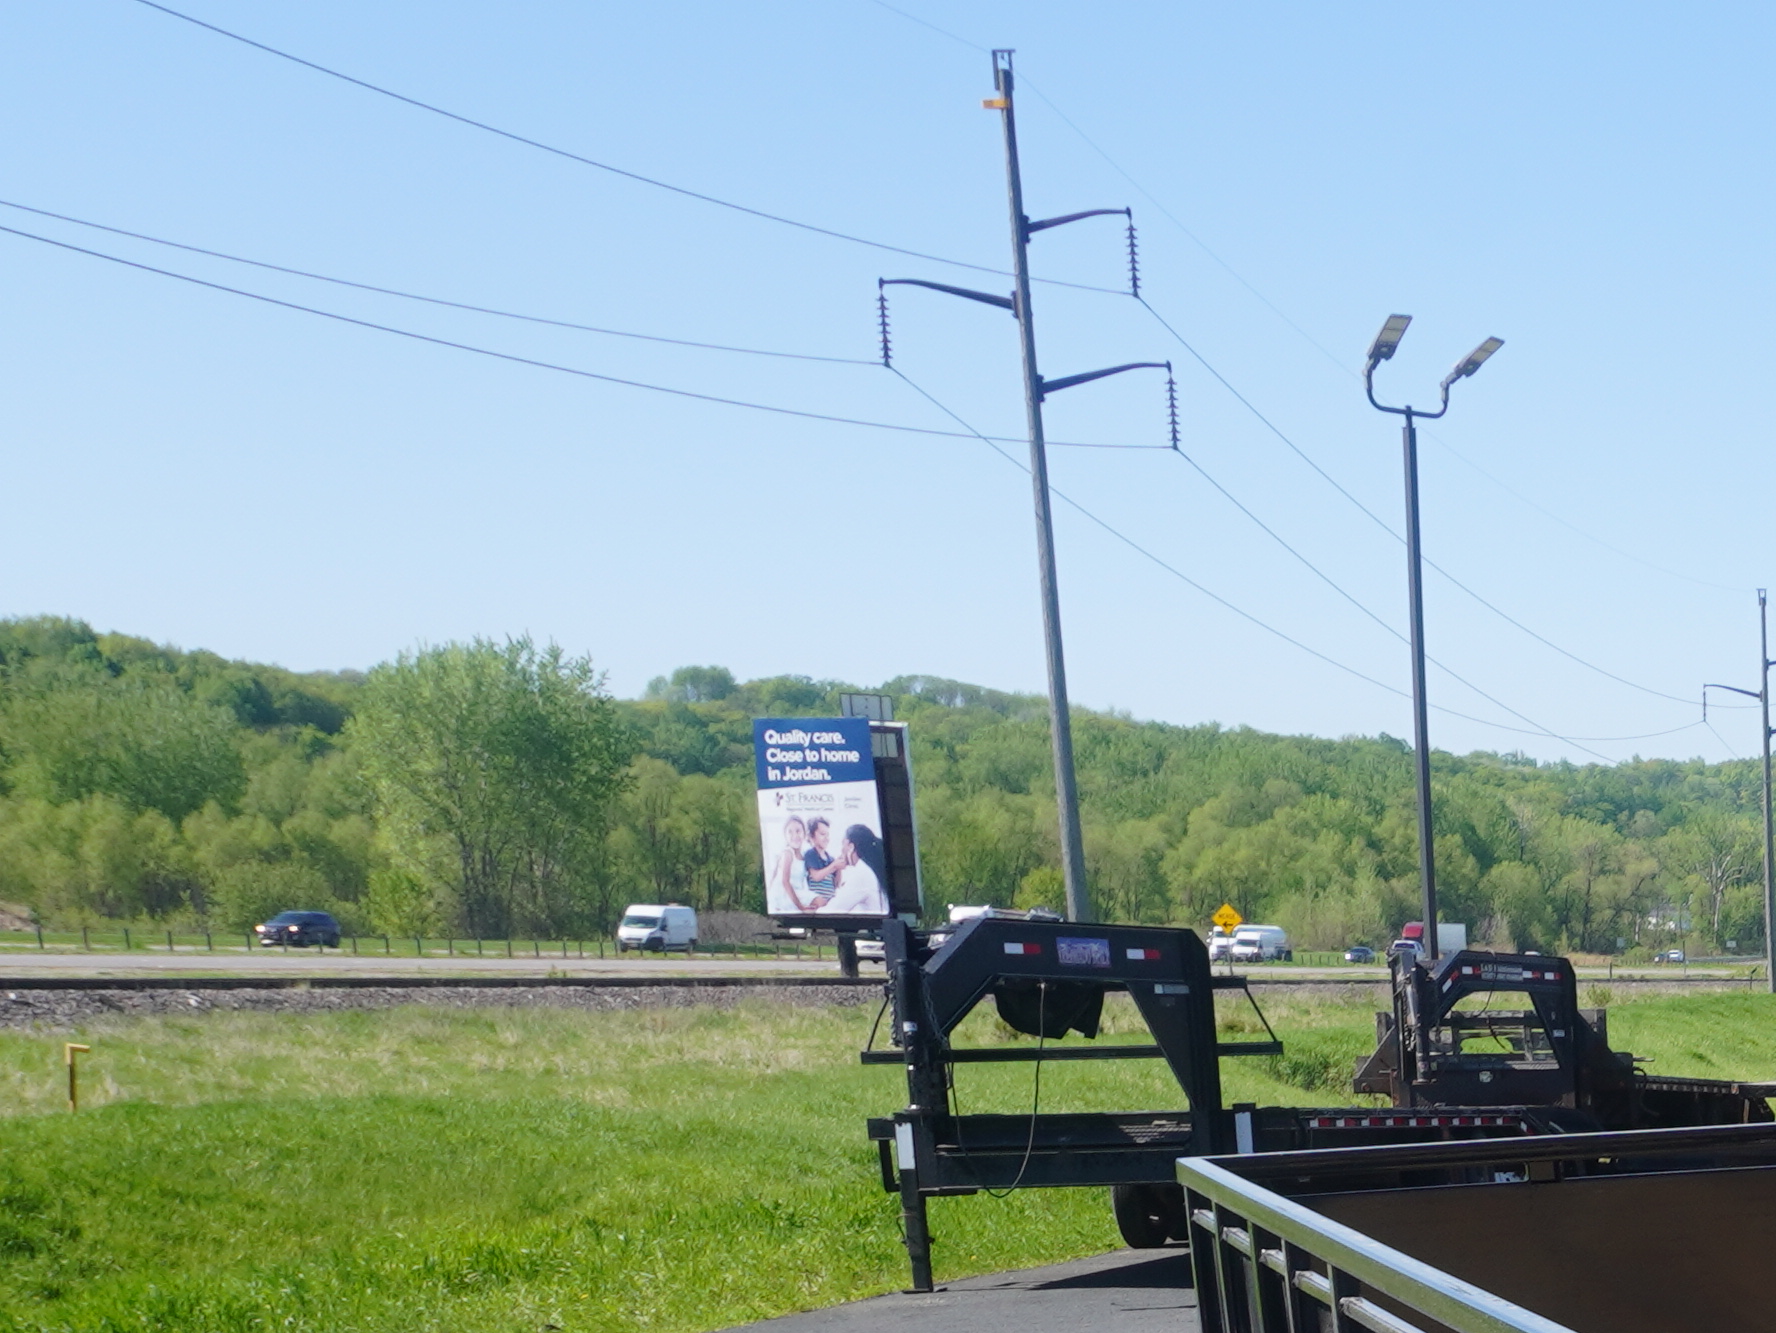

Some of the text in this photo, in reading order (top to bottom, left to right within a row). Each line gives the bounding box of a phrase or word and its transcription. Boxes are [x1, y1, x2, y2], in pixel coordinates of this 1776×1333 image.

[764, 729, 846, 747] Quality care.
[766, 748, 860, 763] Close to home
[767, 766, 832, 781] in Jordan.
